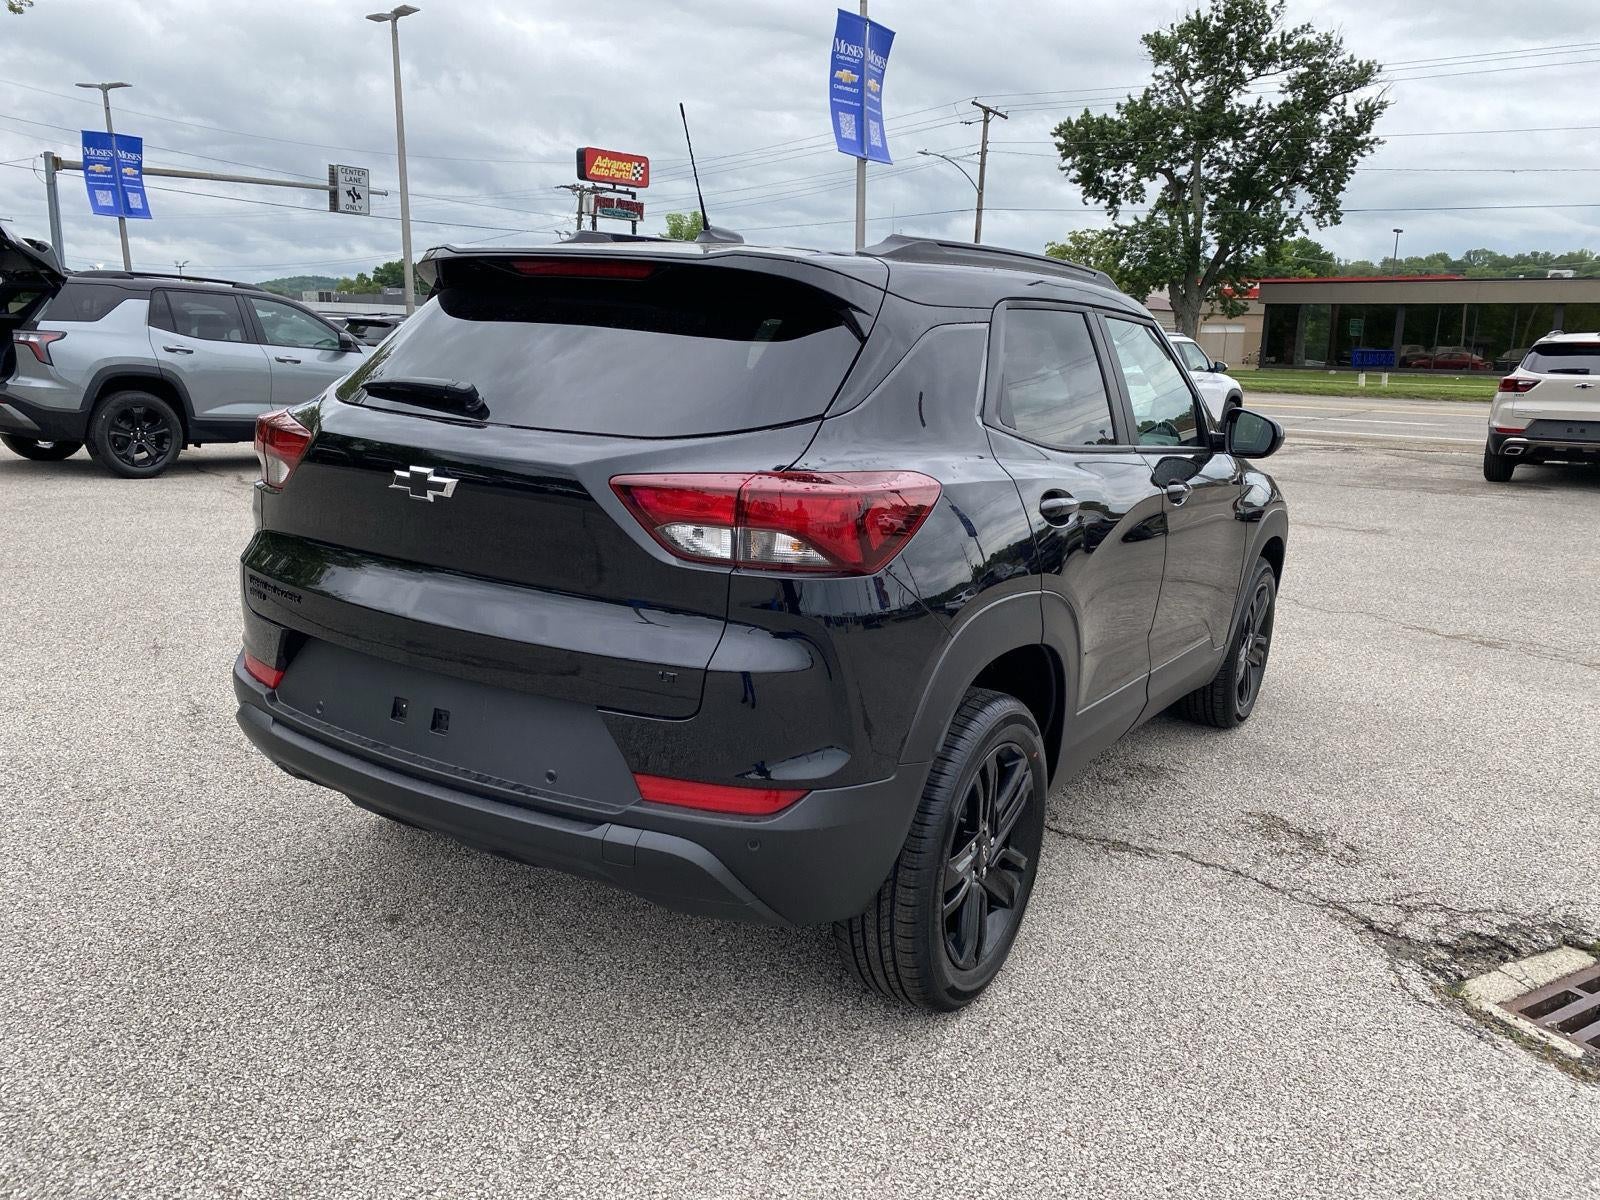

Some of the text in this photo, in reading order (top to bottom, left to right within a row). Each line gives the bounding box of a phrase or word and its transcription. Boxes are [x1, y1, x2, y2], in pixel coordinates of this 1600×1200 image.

[833, 38, 864, 59] MOSES
[867, 48, 887, 70] MOSES
[833, 84, 859, 94] CHEVROLET
[83, 146, 114, 157] MOSES
[116, 149, 142, 161] MOSES
[594, 156, 631, 171] Advance
[341, 167, 366, 177] CENTER
[590, 165, 630, 179] Auto Parts
[344, 176, 363, 184] LANE
[345, 203, 363, 211] ONLY
